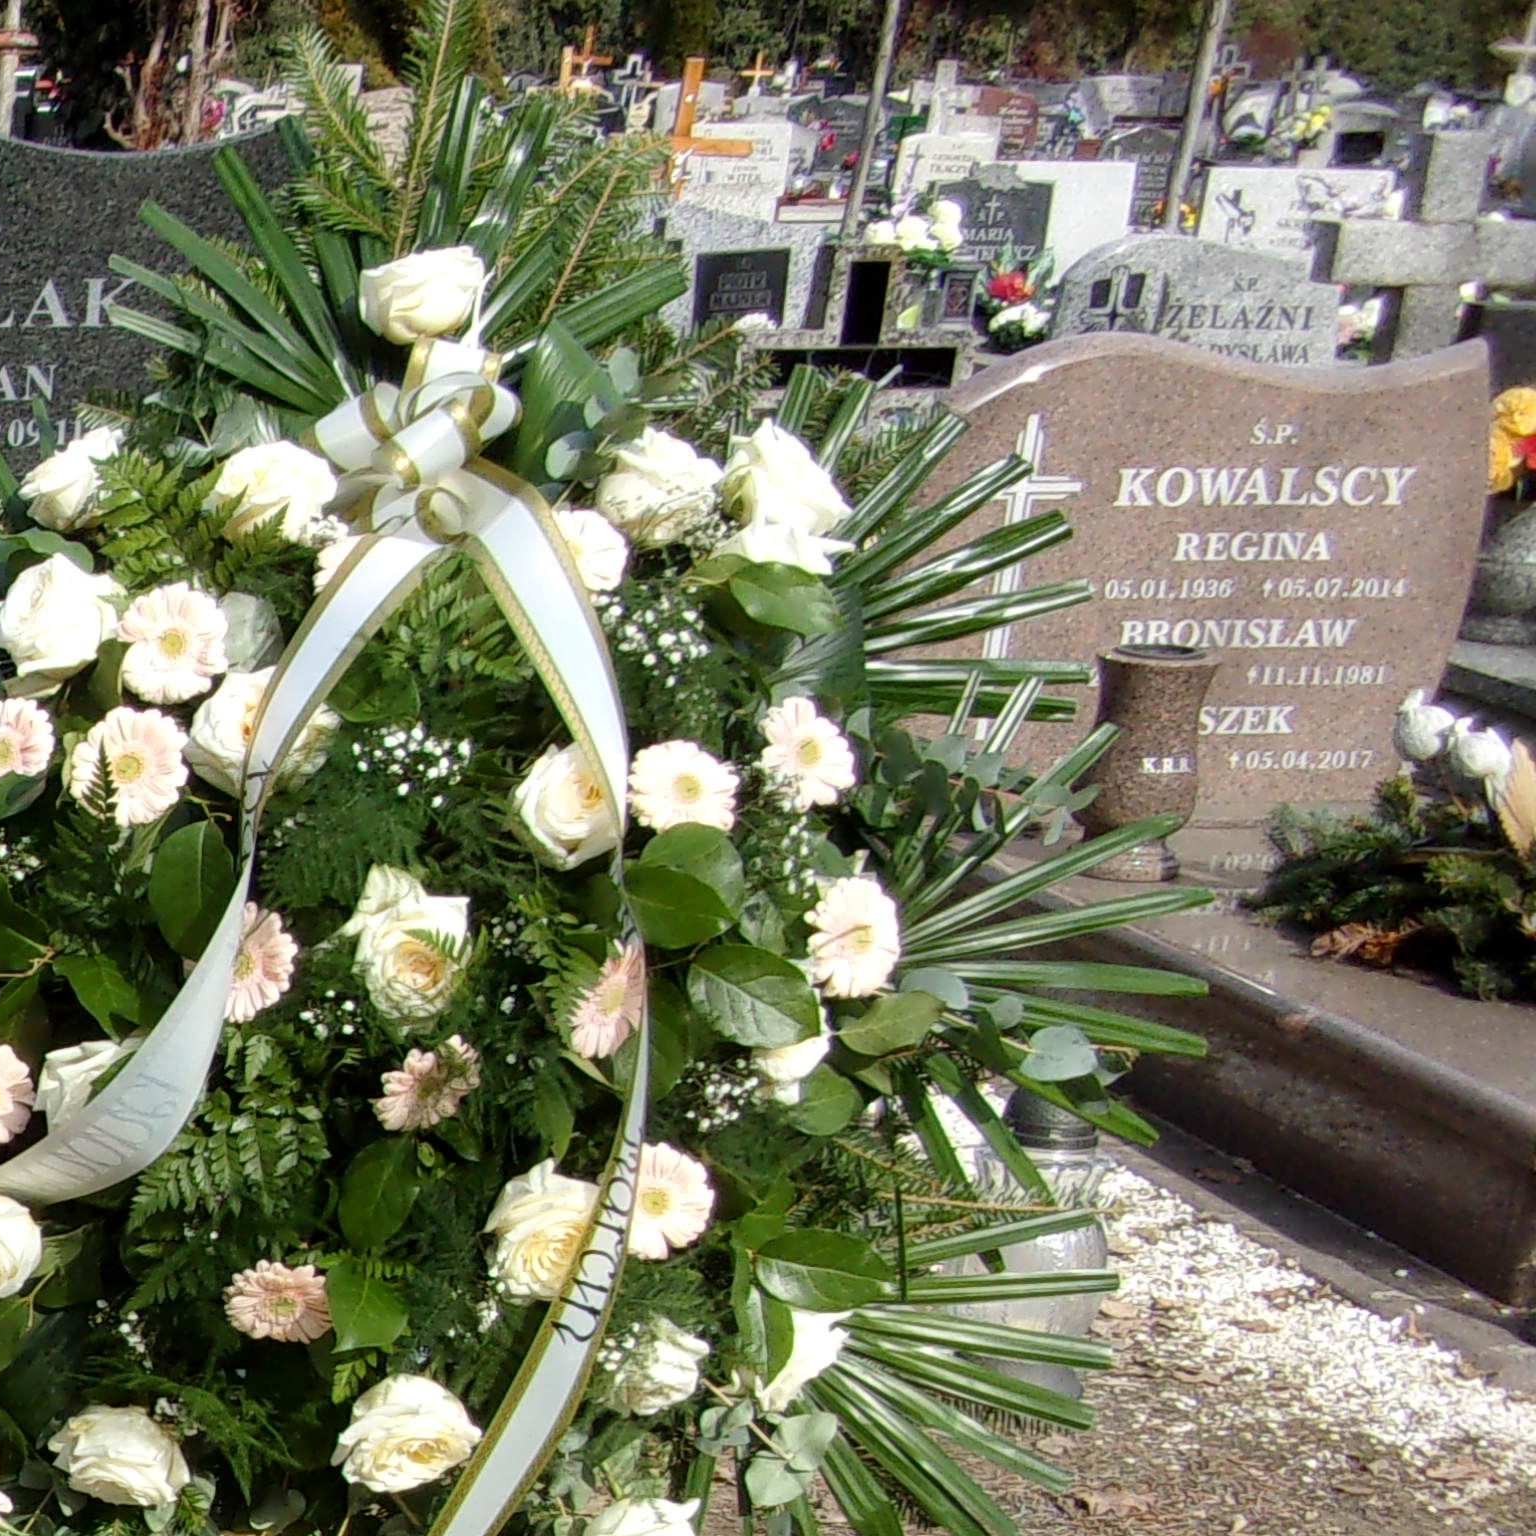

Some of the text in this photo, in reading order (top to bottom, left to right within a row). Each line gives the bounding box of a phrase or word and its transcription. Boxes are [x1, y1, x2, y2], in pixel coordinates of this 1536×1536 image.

[1165, 297, 1315, 330] ŻELAŹNI
[1251, 419, 1299, 446] Ś.P.
[1113, 465, 1416, 507] KOWALSCY
[1173, 531, 1332, 562] REGINA
[1104, 577, 1408, 600] 05.01.1936 05.07.2014
[1120, 618, 1357, 648] BRONISŁAW
[1261, 665, 1386, 686] 11.11.1981
[1198, 705, 1296, 735] SZEK
[1245, 749, 1375, 771] 05.04.2017
